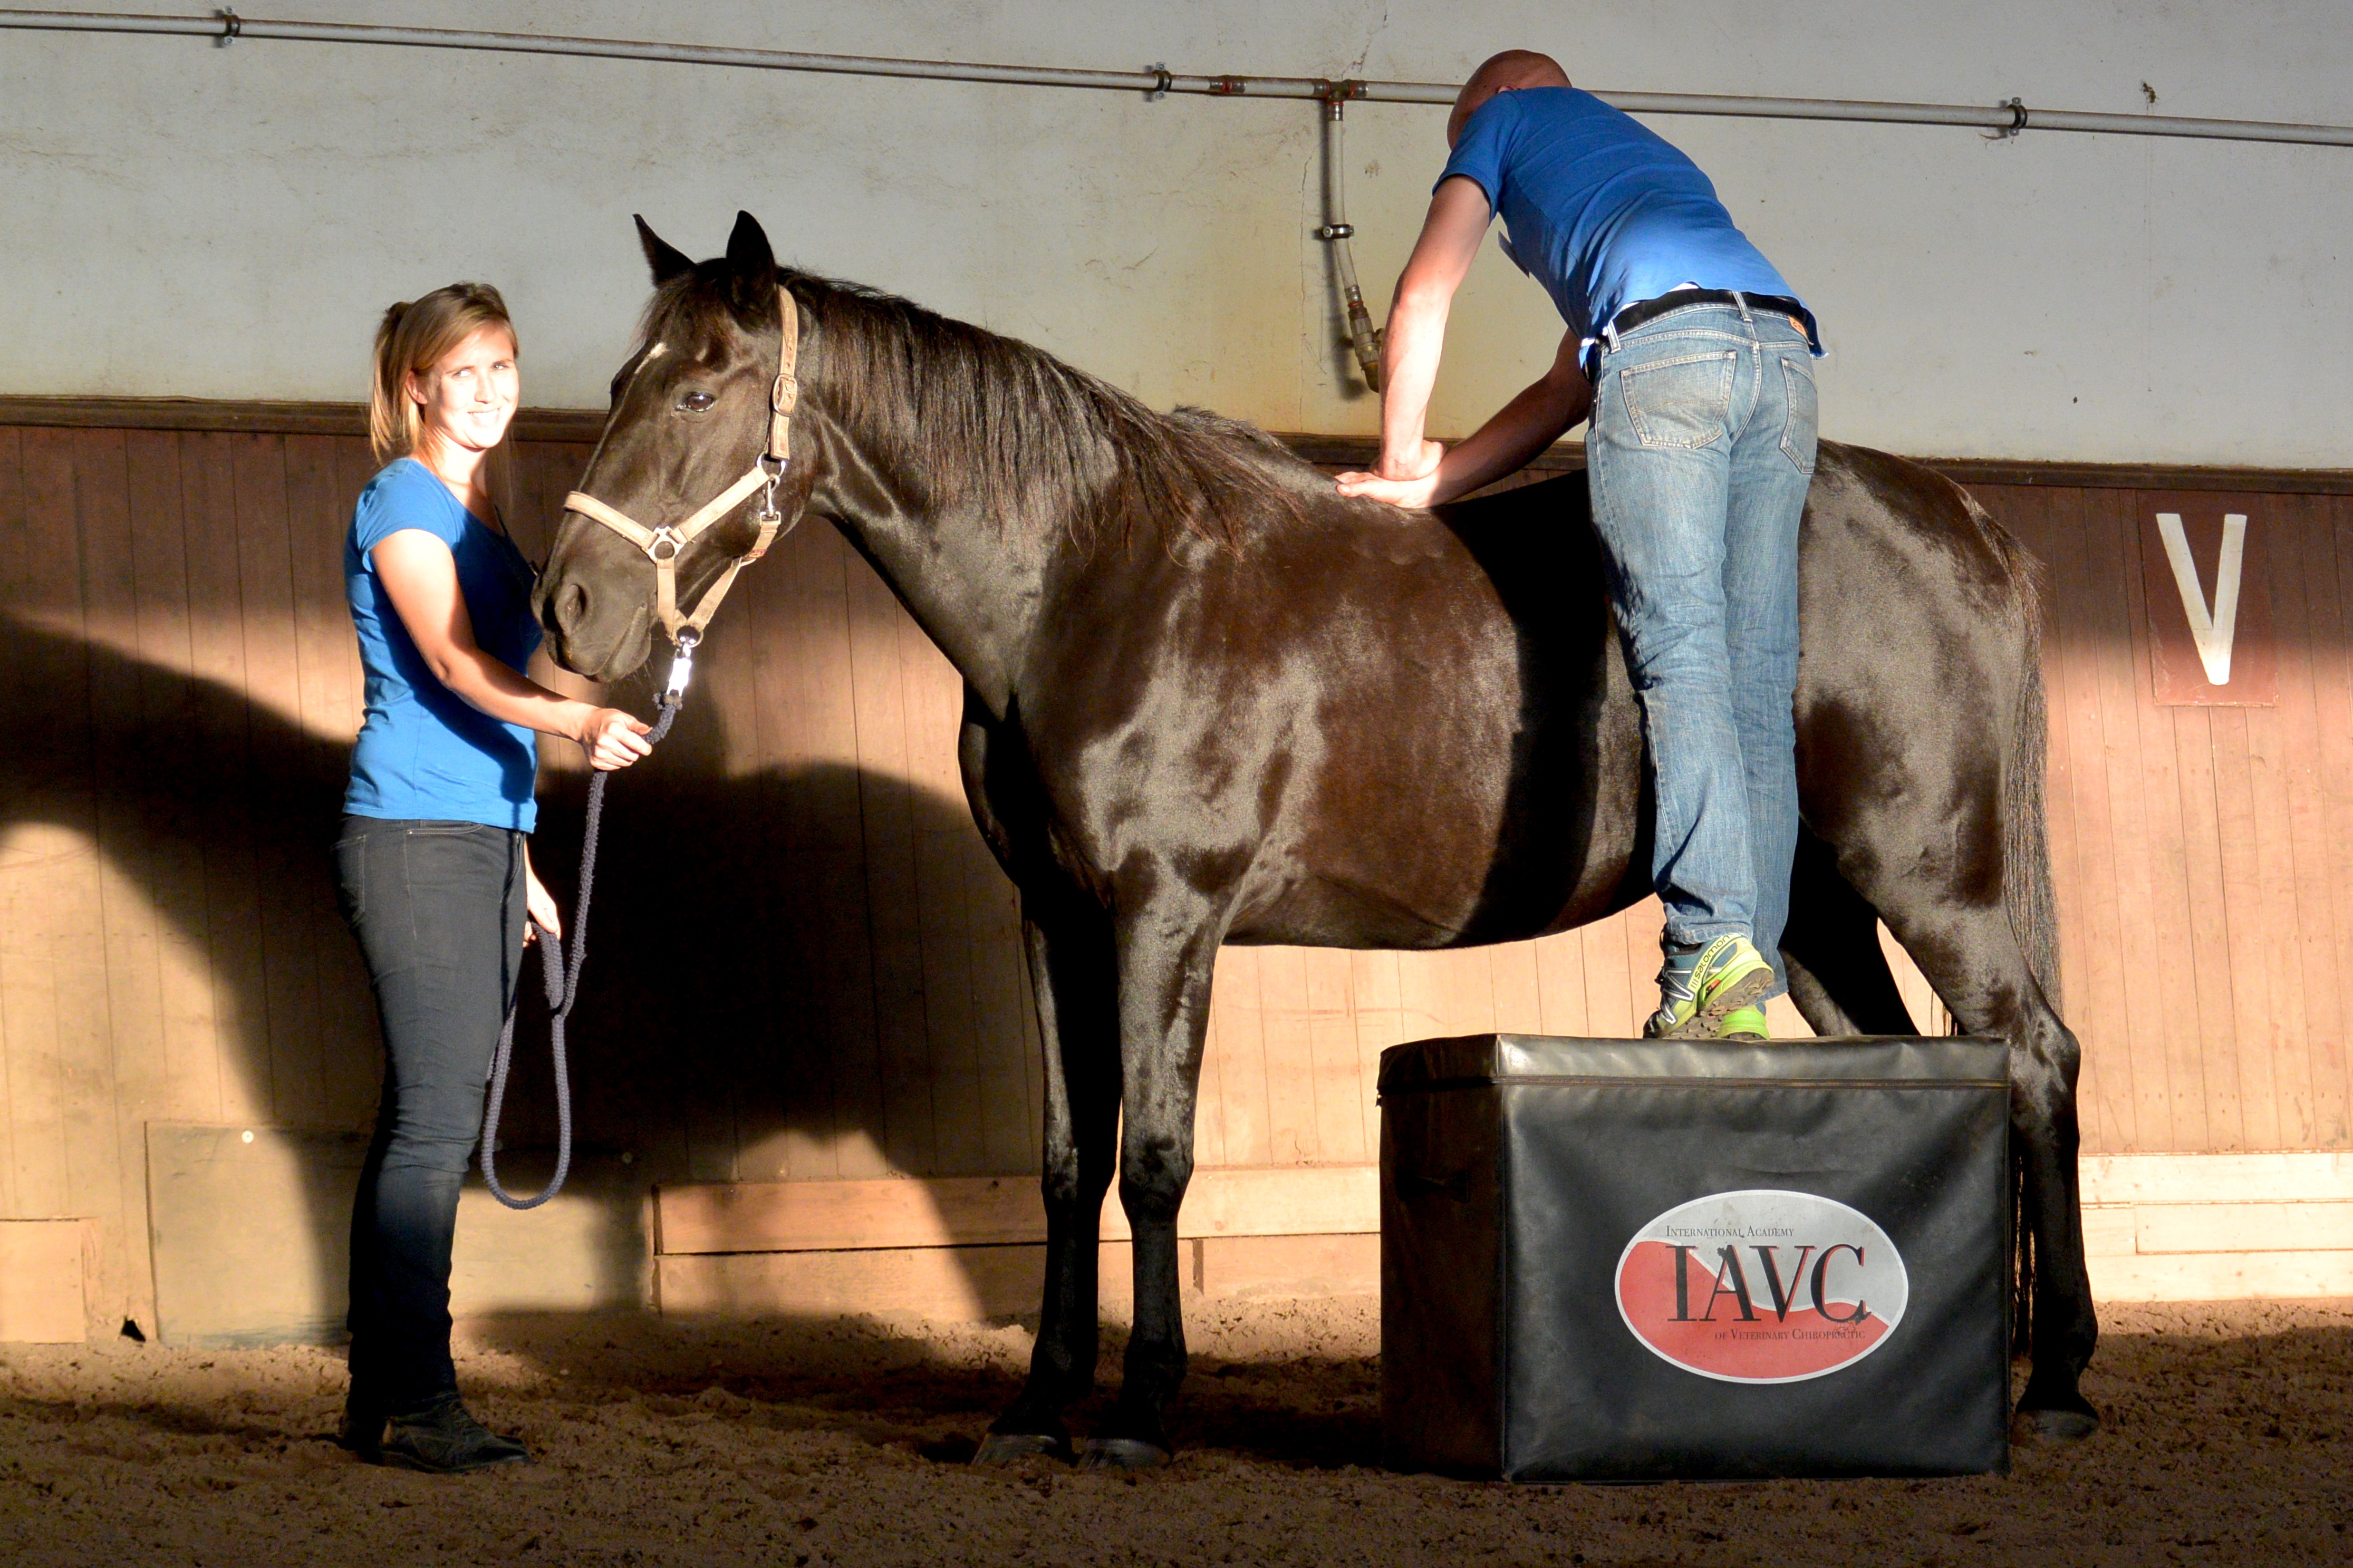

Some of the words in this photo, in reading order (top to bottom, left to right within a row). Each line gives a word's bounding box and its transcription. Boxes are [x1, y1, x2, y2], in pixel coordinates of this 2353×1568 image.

[2156, 513, 2248, 685] V
[1666, 1225, 1742, 1237] INTERNATIONAL
[1747, 1225, 1795, 1237] ACADEMY
[1665, 1243, 1869, 1323] IAVC
[1730, 1328, 1790, 1340] VETERINARY
[1792, 1328, 1866, 1340] CHIROPRACTIC
